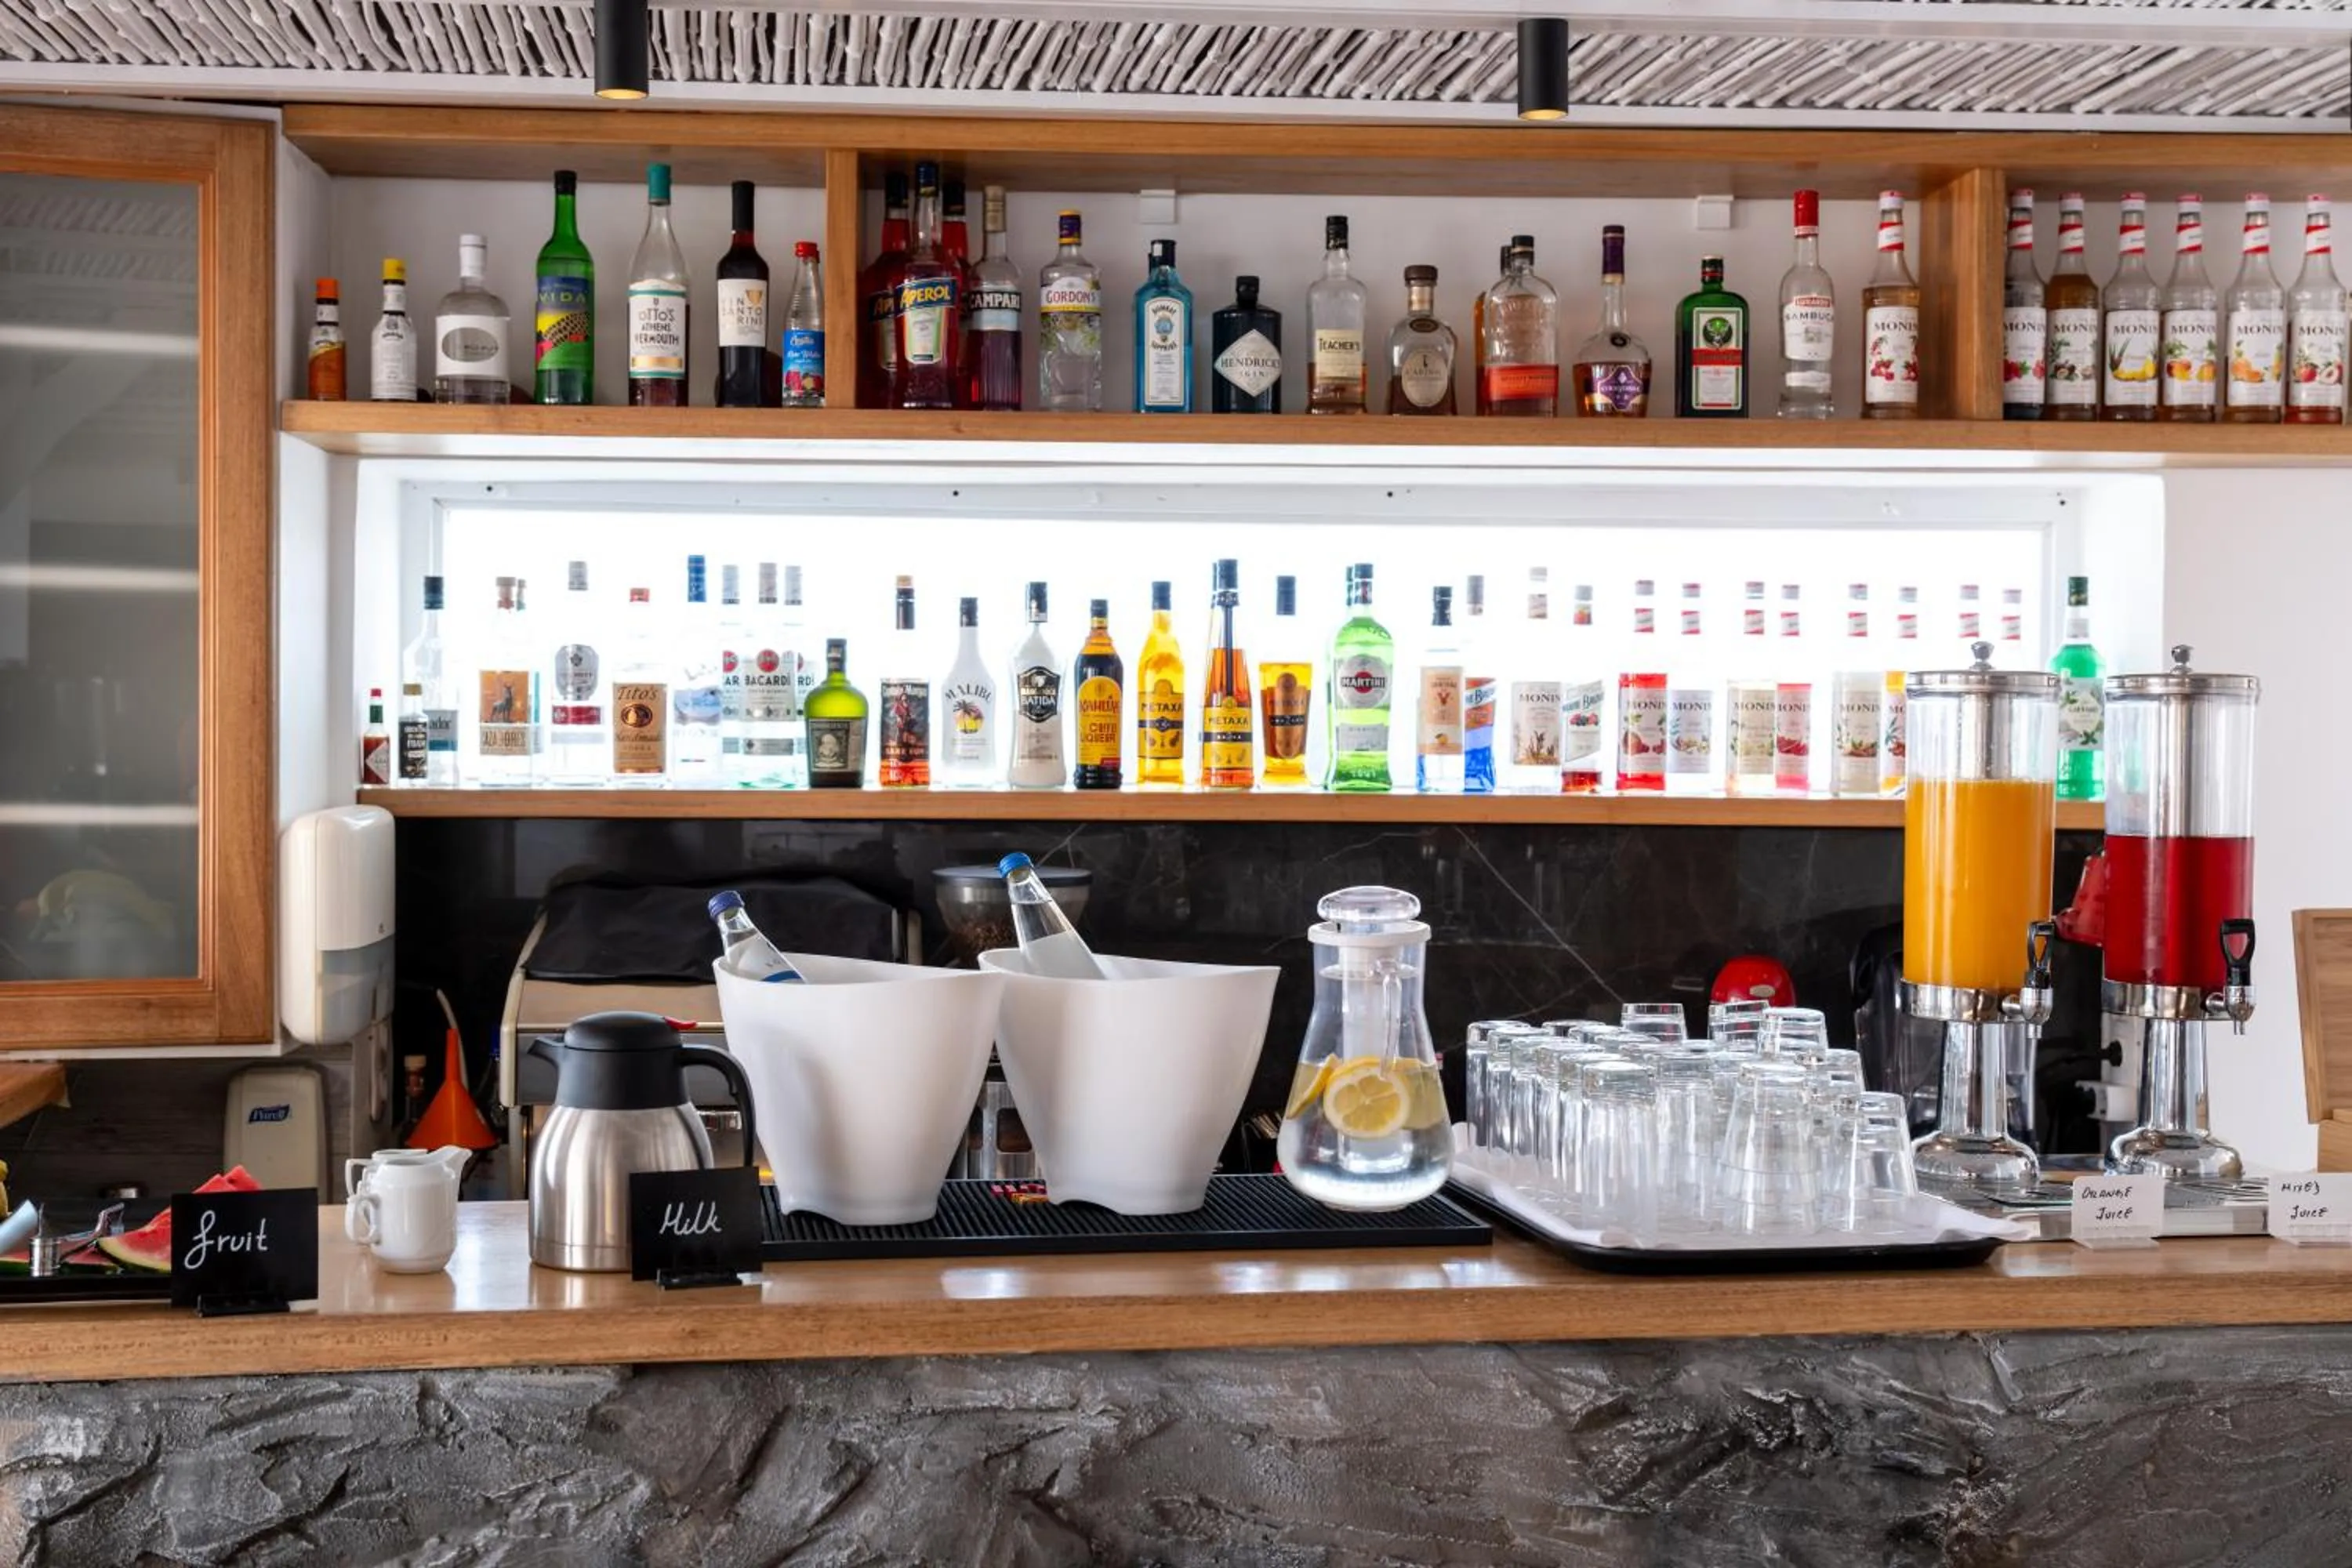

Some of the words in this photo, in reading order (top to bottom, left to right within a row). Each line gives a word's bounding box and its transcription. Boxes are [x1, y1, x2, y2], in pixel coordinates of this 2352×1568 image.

[539, 291, 586, 304] VIDA
[900, 285, 952, 308] APEROL
[970, 292, 1021, 308] CAMPARI
[641, 322, 671, 332] ATHENS
[737, 316, 763, 326] RINI
[634, 333, 680, 346] VERMOUTH
[1319, 338, 1360, 352] TEACHER'S
[1341, 677, 1386, 688] MARTINI
[617, 685, 659, 701] Tito's
[1021, 695, 1057, 706] BATIDA
[1141, 702, 1182, 713] METAXA
[1208, 717, 1249, 726] METAXA
[2082, 1186, 2132, 1200] ORANGE
